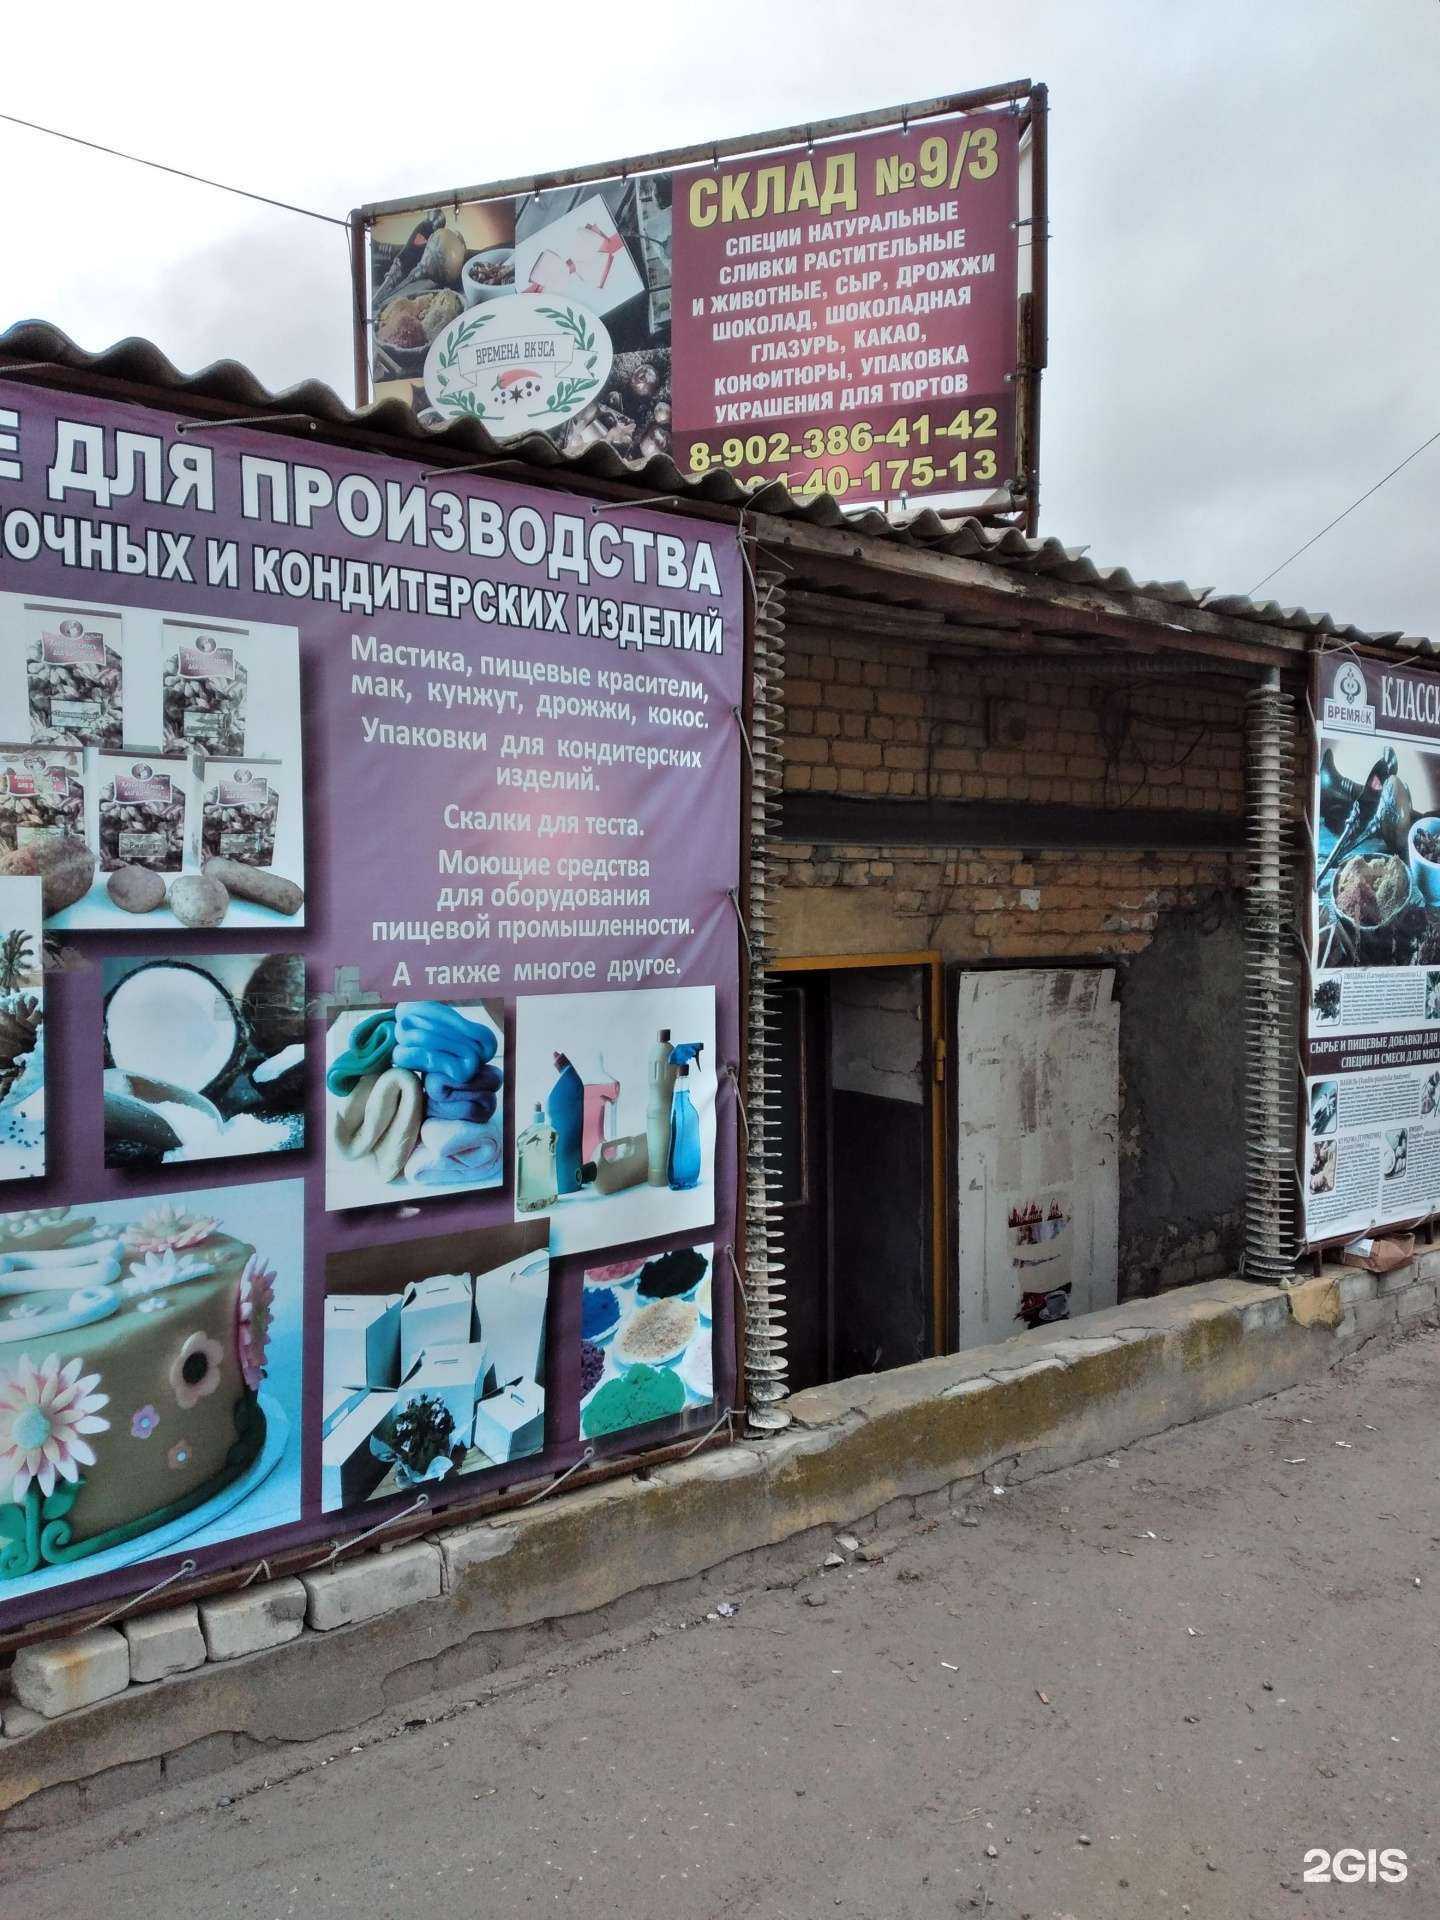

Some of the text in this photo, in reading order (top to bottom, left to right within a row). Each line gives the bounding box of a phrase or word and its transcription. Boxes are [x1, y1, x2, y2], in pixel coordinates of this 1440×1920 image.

[689, 127, 999, 228] СКЛАД №9/3
[726, 201, 958, 256] СПЕЦИИ НАТУРАЛЬНЫЕ
[720, 228, 965, 285] СЛИВКИ РАСТИТЕЛЬНЫЕ
[692, 253, 996, 316] И ЖИВОТНЫЕ, СЫР, ДРОЖЖИ
[712, 286, 971, 341] ШОКОЛАД, ШОКОЛАДНАЯ
[476, 340, 555, 365] ВРЕМЕНА ВКУСА
[751, 322, 927, 363] ГЛАЗУРЬ, КАКАО,
[715, 344, 968, 397] КОНФИТЮРЫ, УПАКОВКА
[715, 374, 968, 424] УКРАШЕНИЯ ДЛЯ ТОРТОВ
[689, 406, 998, 472] 8-902-386-41-42
[48, 418, 215, 513] ДЛЯ
[240, 453, 723, 597] ПРОИЗВОДСТВА
[206, 537, 239, 589] И
[252, 544, 570, 634] КОНДИТЕРСКИХ
[577, 594, 724, 655] ИЗДЕЛИЙ
[351, 634, 709, 704] Мастика, пищевые красители,
[351, 673, 709, 729] мак, кунжут, дрожжи, кокос.
[361, 716, 702, 769] Упаковки для кондитерских
[497, 765, 600, 792] изделий.
[443, 804, 645, 837] Скалки для теста.
[438, 849, 650, 881] Моющие средства
[437, 881, 650, 912] для оборудования
[372, 914, 695, 945] пищевой промышленности.
[392, 955, 681, 987] А также многое другое.
[1310, 1041, 1339, 1054] СЫРЬЕ
[1347, 1037, 1388, 1051] ПИЩЕВЫЕ
[1388, 1033, 1423, 1048] ДОБАВКИ
[1423, 1032, 1438, 1045] ДЛЯ
[1342, 1055, 1373, 1068] СПЕЦИИ
[1380, 1051, 1405, 1064] СМЕСИ
